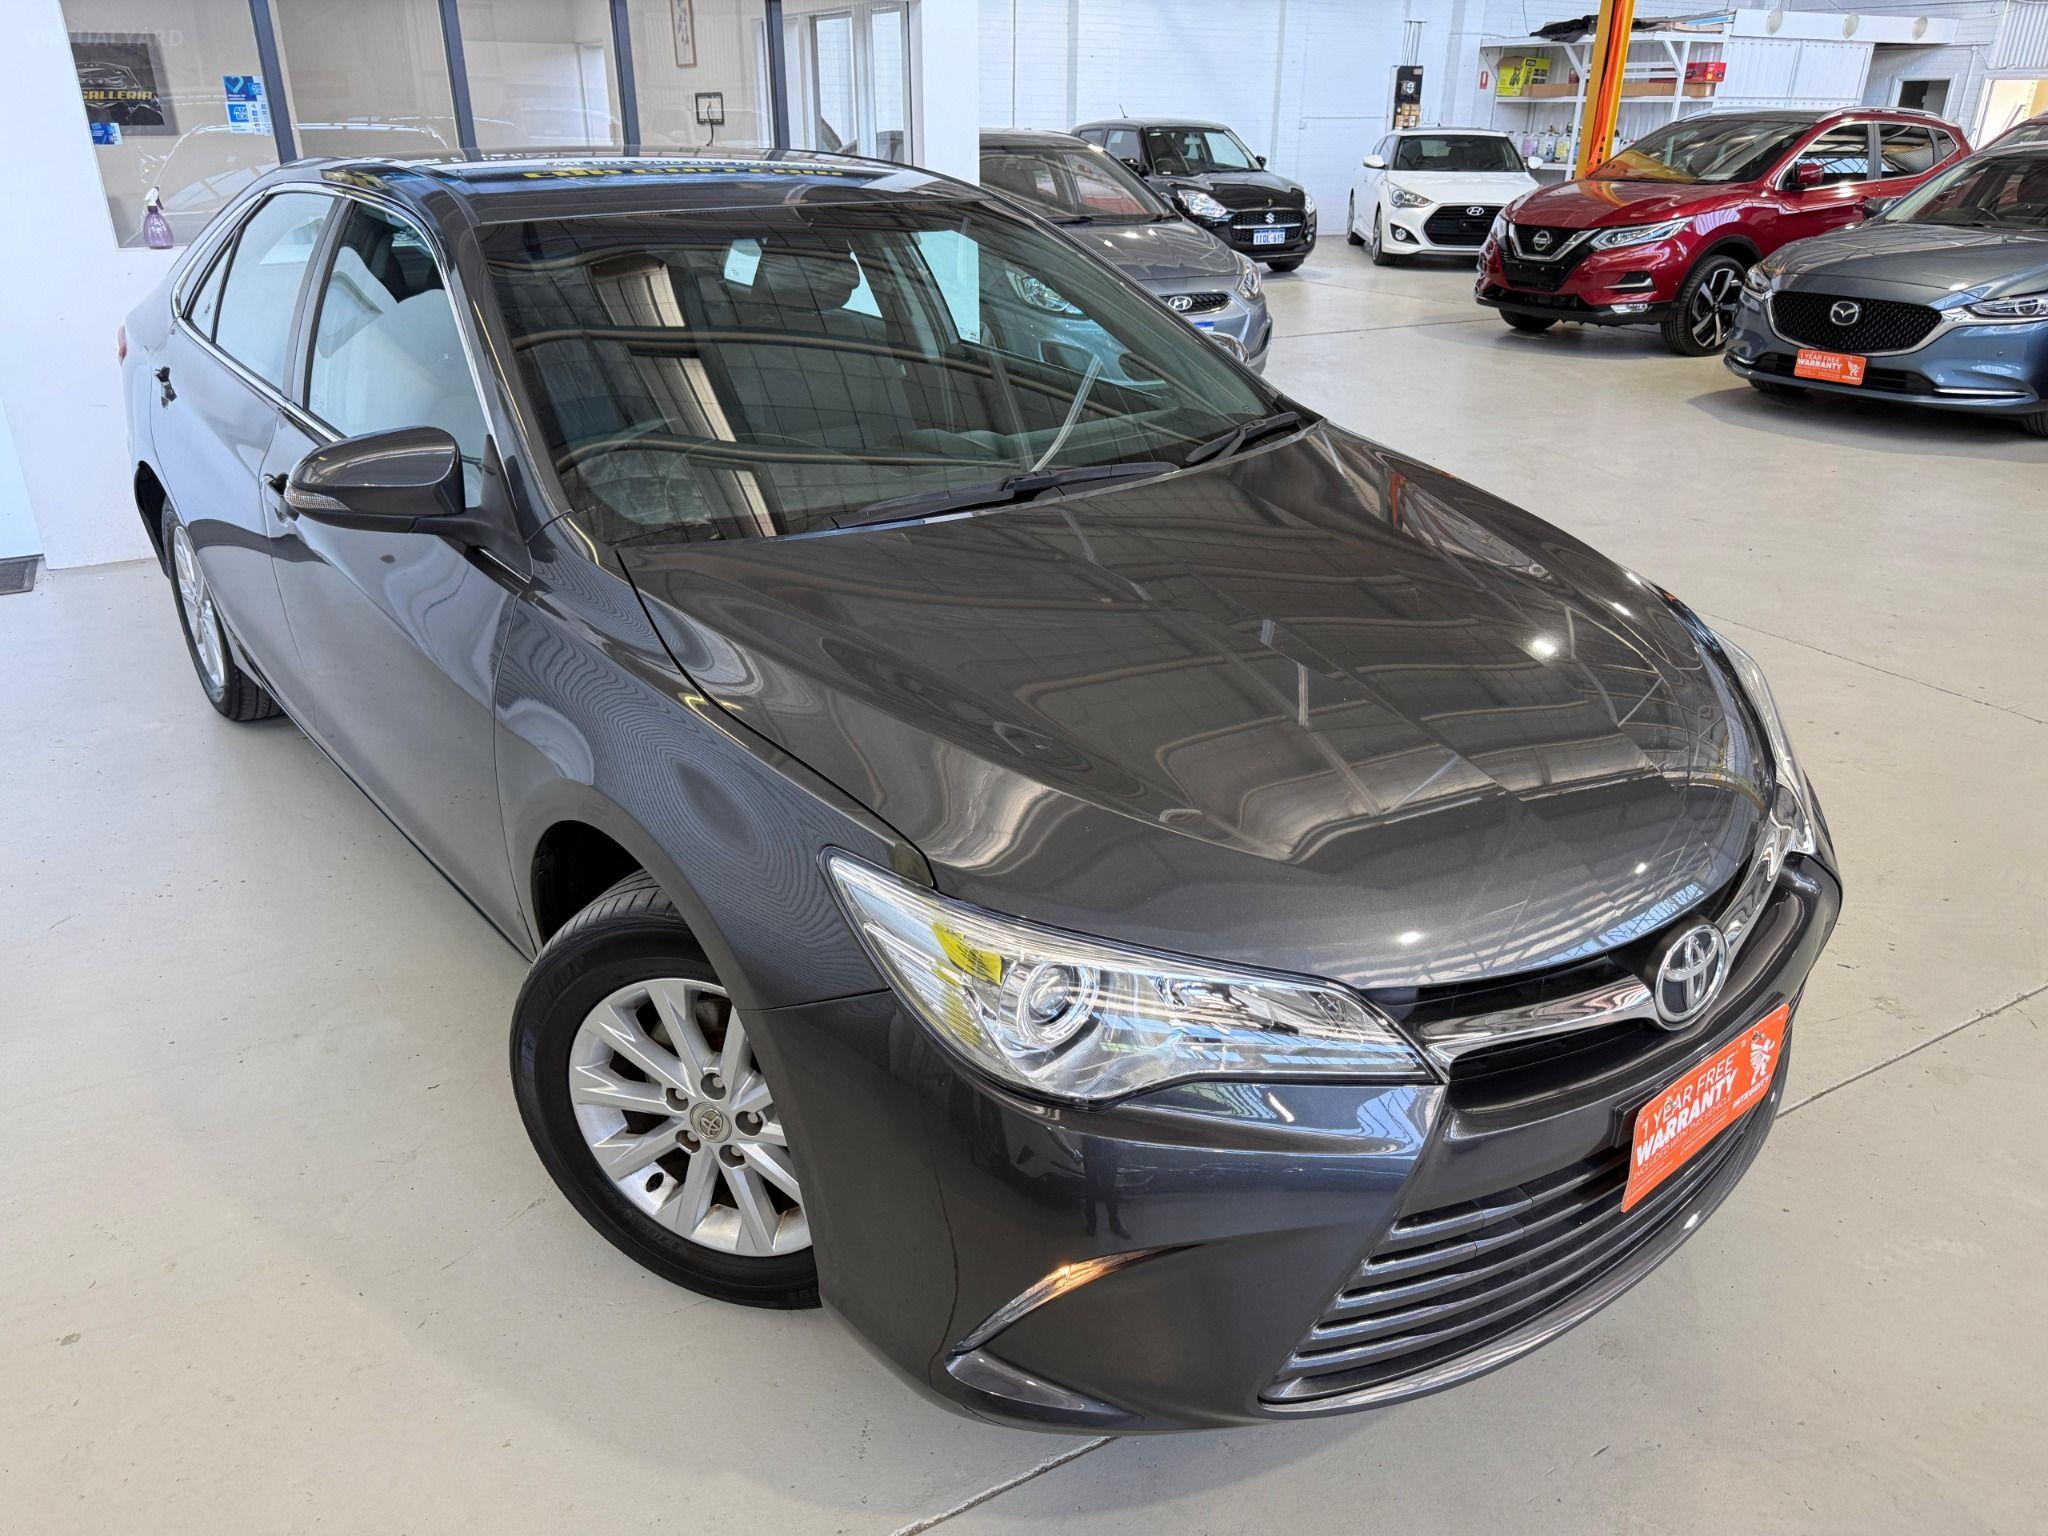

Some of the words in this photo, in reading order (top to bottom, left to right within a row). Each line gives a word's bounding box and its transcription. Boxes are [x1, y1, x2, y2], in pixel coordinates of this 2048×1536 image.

[1798, 358, 1842, 370] WARRANTY
[1637, 1068, 1739, 1167] WARRANTY
[1643, 1119, 1649, 1140] 1
[1653, 1084, 1694, 1130] YEAR
